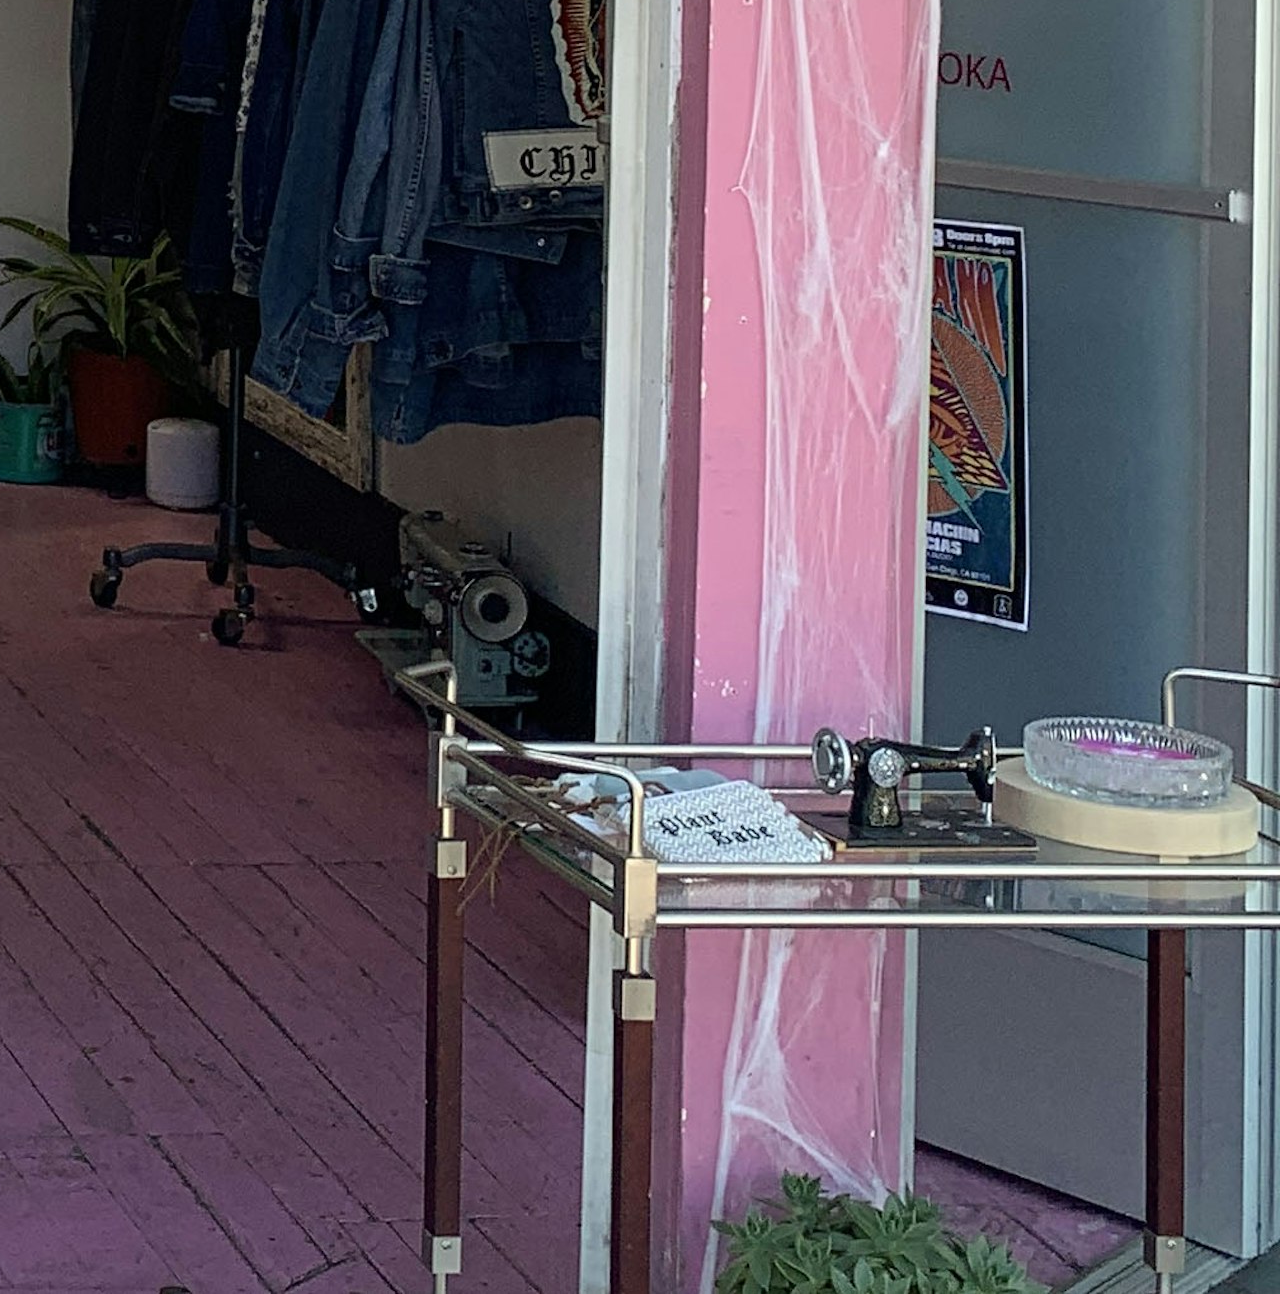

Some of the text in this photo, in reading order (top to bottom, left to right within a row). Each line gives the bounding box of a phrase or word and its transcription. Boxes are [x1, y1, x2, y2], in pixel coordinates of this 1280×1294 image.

[938, 52, 1011, 92] OKA
[520, 143, 606, 186] CHI
[656, 811, 725, 837] Plant
